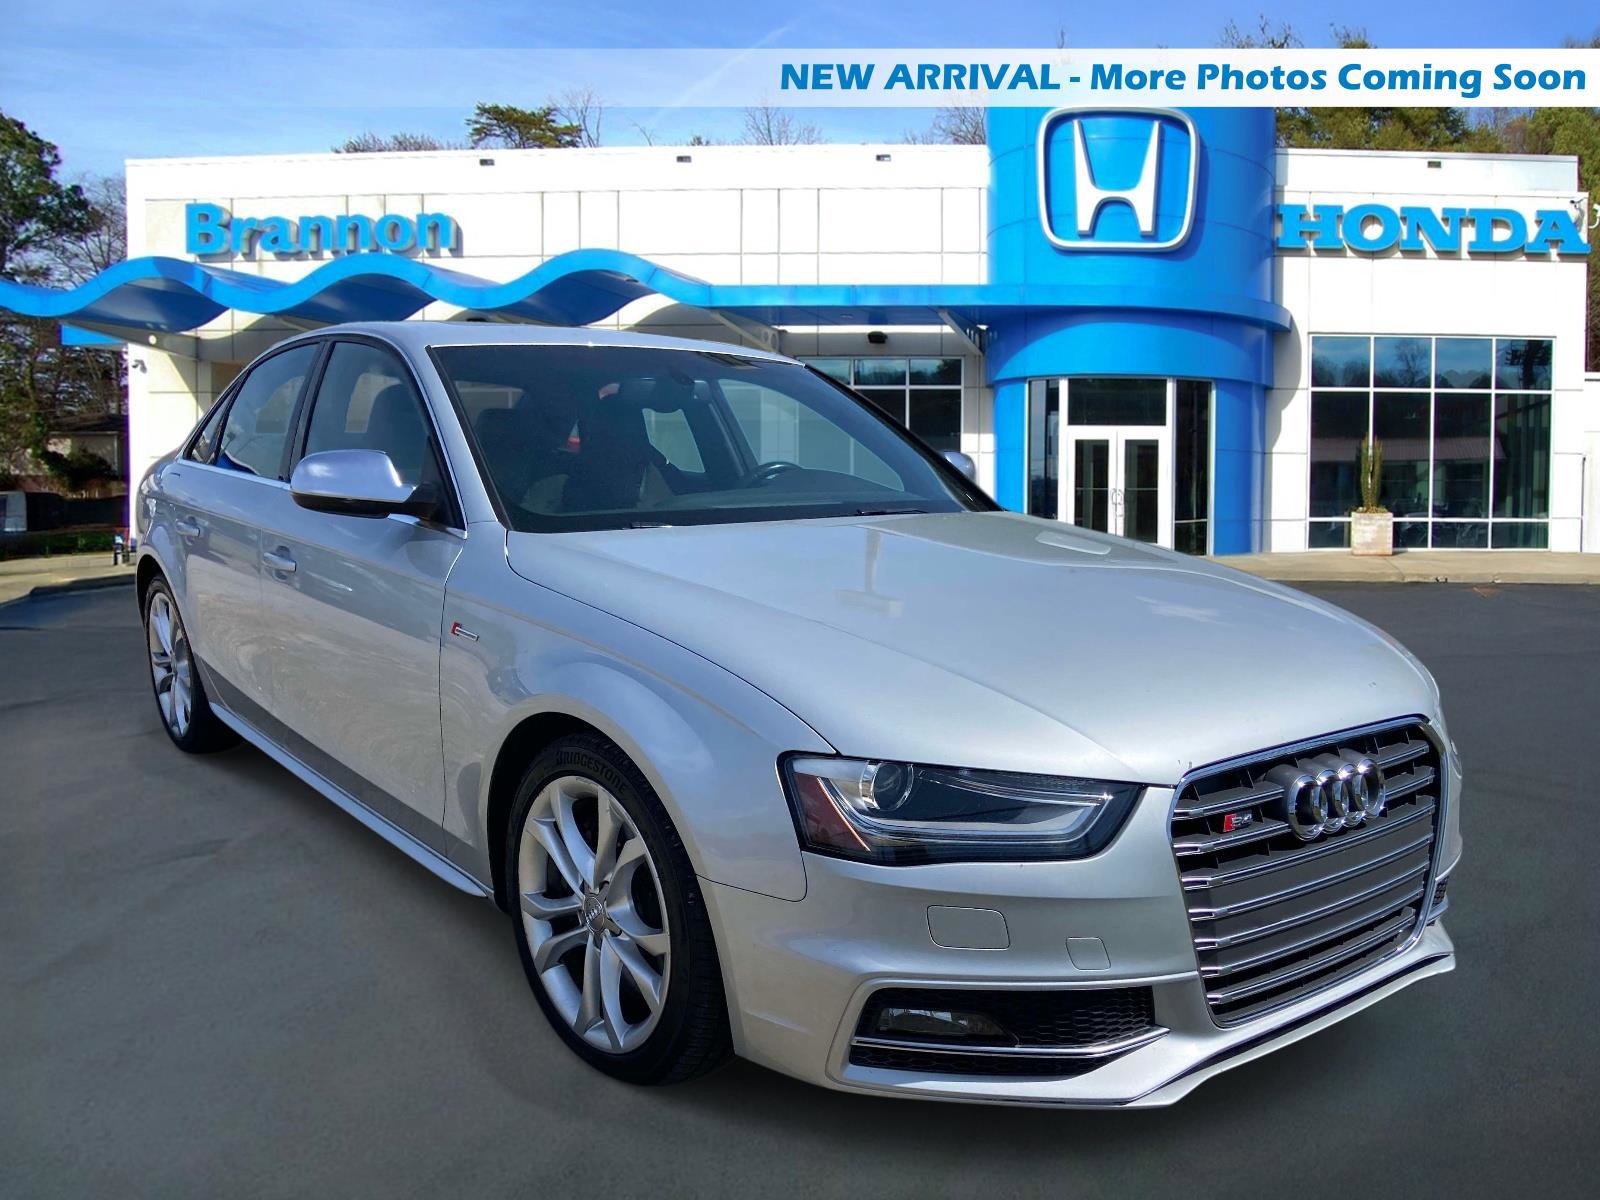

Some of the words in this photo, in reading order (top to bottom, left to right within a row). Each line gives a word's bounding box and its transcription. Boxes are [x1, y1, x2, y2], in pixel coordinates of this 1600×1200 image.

[185, 202, 456, 255] Brannon
[1276, 203, 1592, 255] HONDA
[556, 750, 628, 793] BRIDGESTONE
